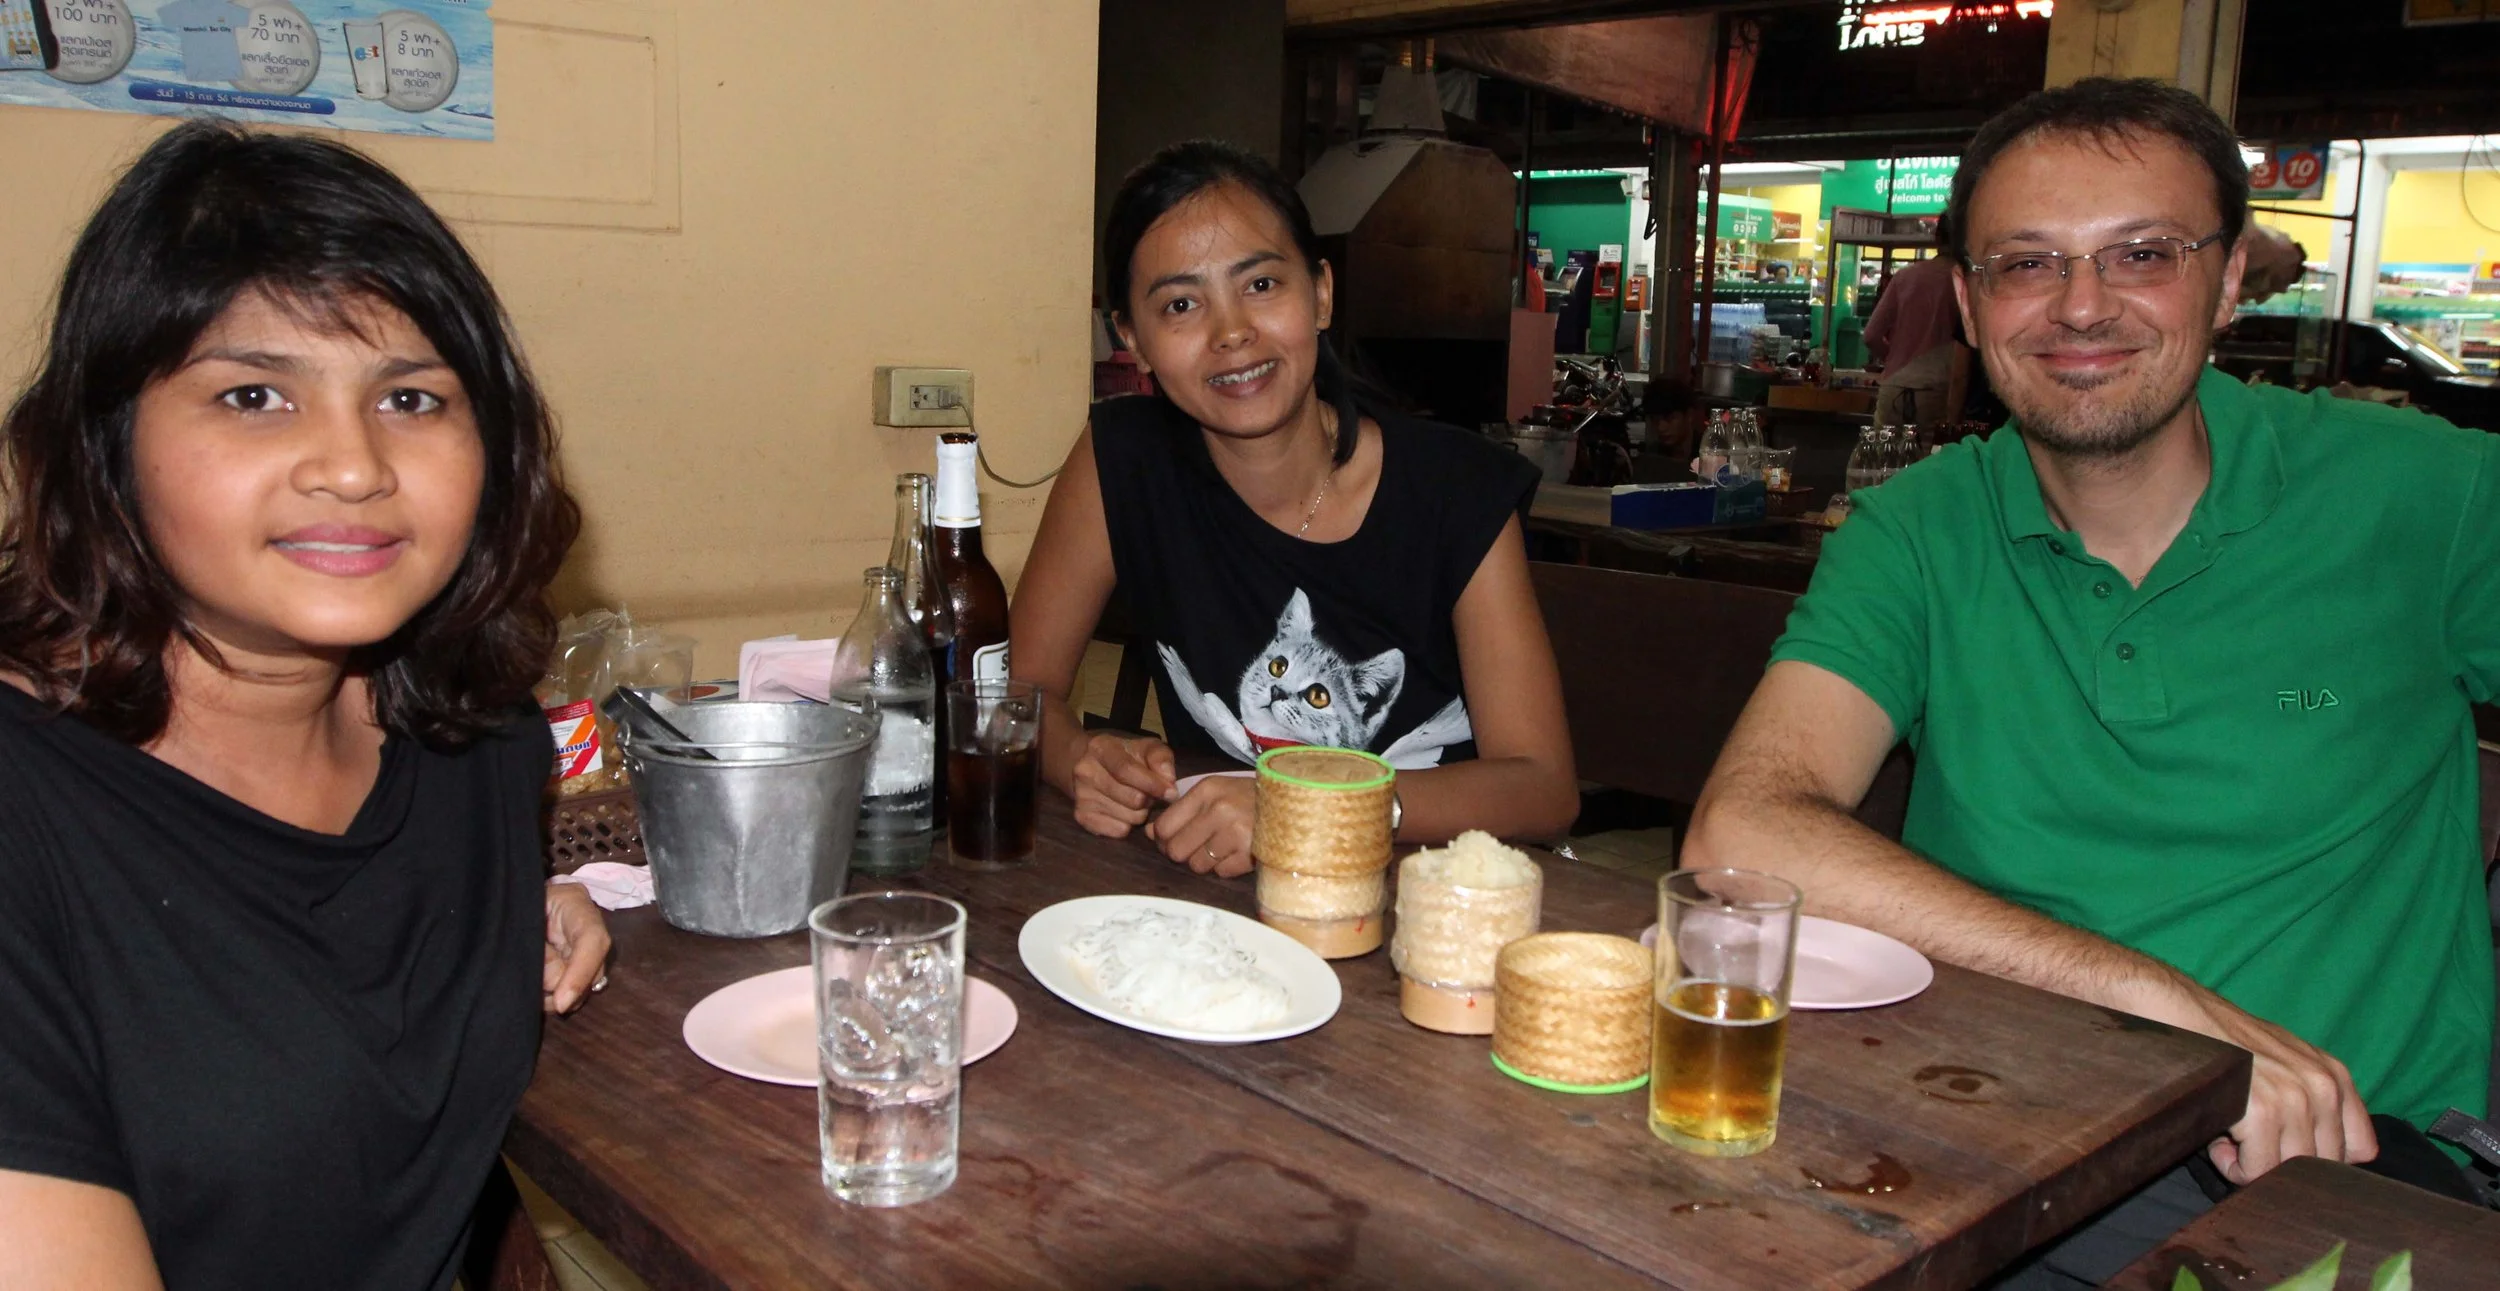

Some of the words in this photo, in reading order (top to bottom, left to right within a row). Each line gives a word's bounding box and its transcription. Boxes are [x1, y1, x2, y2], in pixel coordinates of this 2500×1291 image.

[55, 7, 83, 21] 100
[90, 14, 117, 24] บาท
[258, 14, 267, 27] 5
[250, 28, 269, 41] 70
[275, 33, 300, 43] บาท
[400, 30, 409, 42] 5
[398, 43, 405, 55] 8
[411, 48, 434, 58] บาท
[184, 91, 195, 100] 15
[2288, 158, 2315, 177] 10
[1886, 193, 1931, 203] Welcome
[1933, 193, 1945, 203] to
[2277, 688, 2339, 711] FILA
